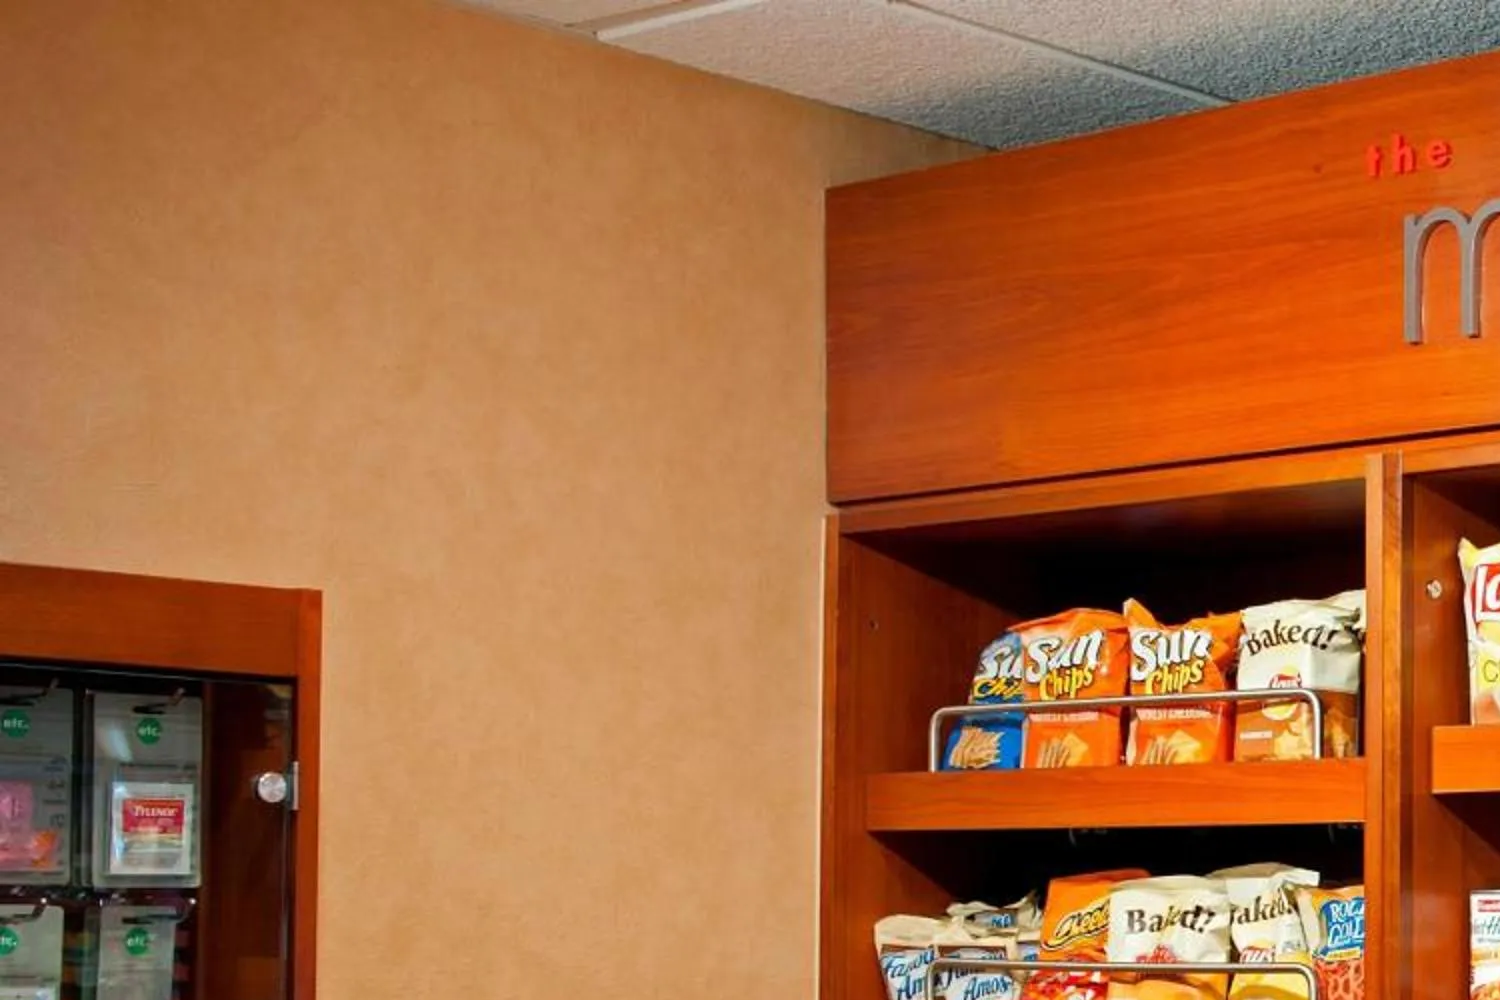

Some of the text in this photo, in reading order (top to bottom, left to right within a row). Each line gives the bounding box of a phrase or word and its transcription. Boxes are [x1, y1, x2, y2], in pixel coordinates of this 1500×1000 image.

[1365, 132, 1453, 178] the
[1025, 629, 1104, 684] Sun
[1130, 629, 1213, 682] Sun
[1145, 659, 1206, 694] Chips
[1039, 663, 1094, 701] Chips
[0, 934, 18, 947] tc.
